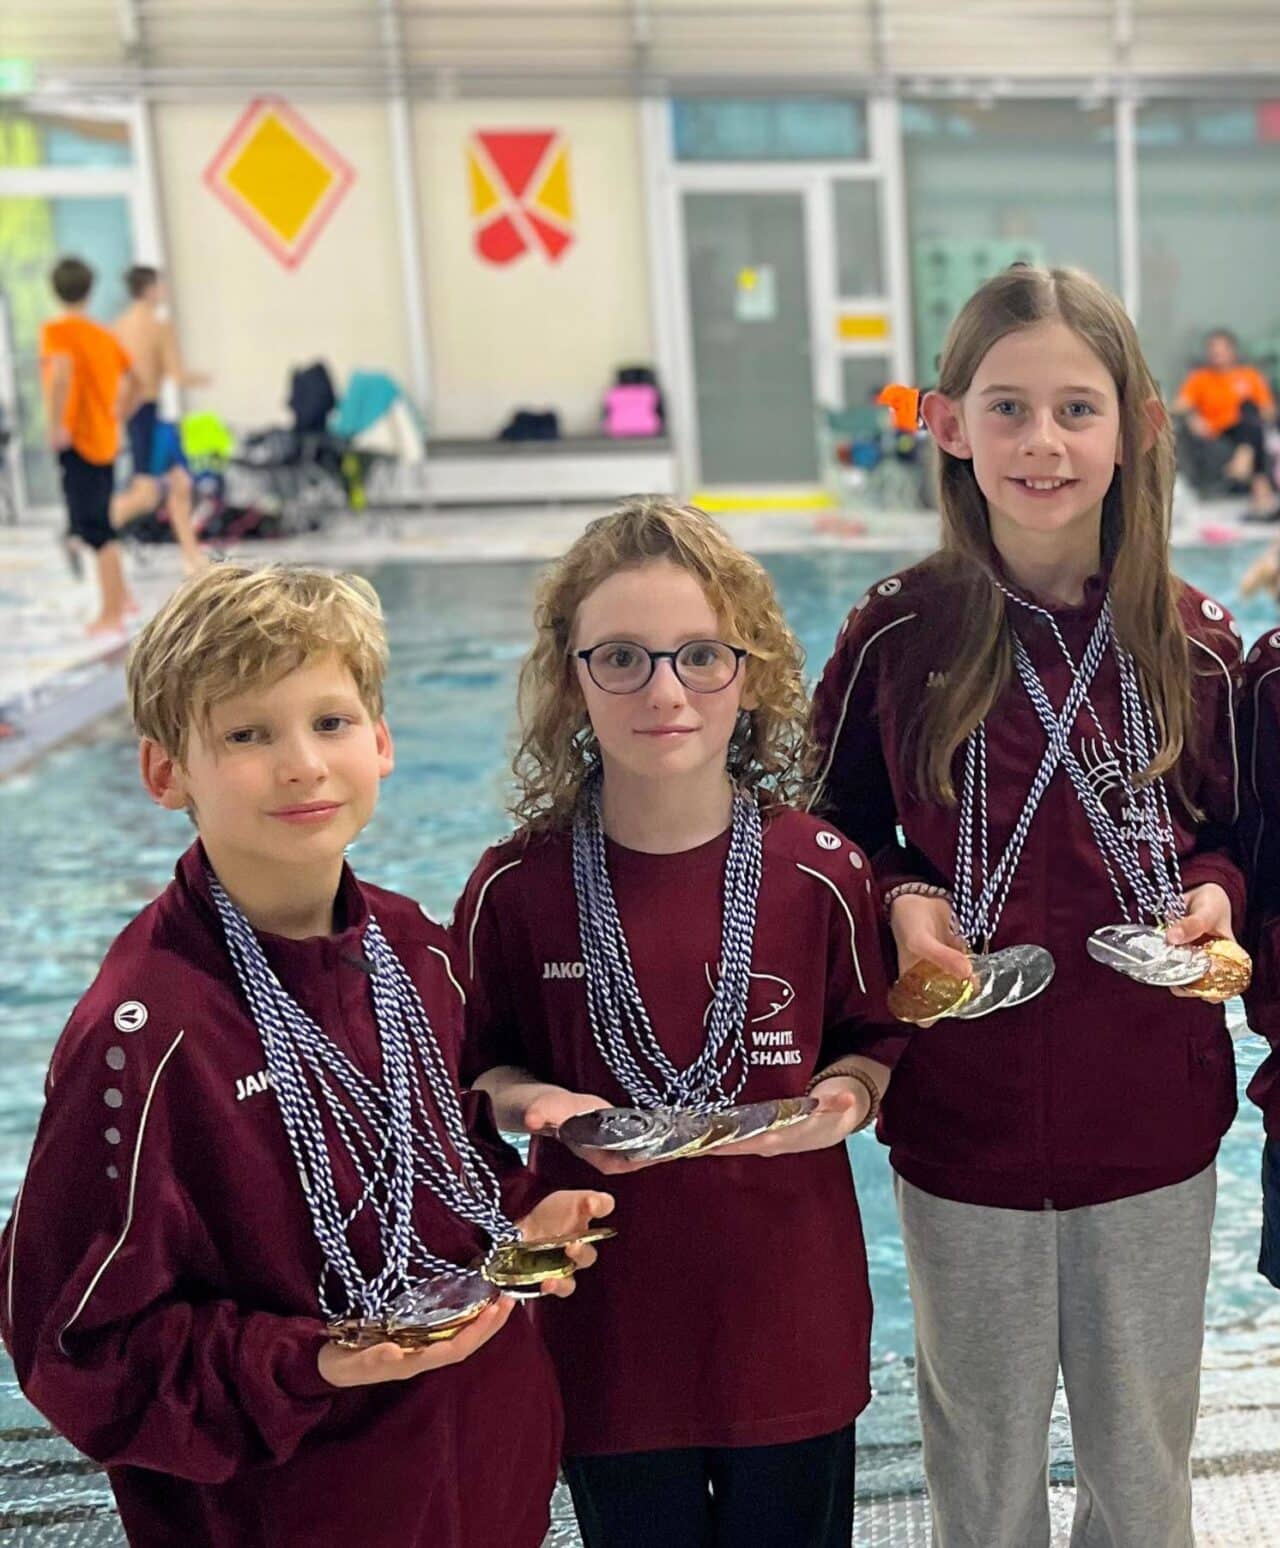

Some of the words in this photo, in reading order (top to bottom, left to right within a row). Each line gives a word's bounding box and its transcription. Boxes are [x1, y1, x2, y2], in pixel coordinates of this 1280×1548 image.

[542, 960, 586, 979] JAKO
[751, 1030, 793, 1047] WHITE
[750, 1049, 802, 1066] SHARKS
[235, 1068, 274, 1101] JAK
